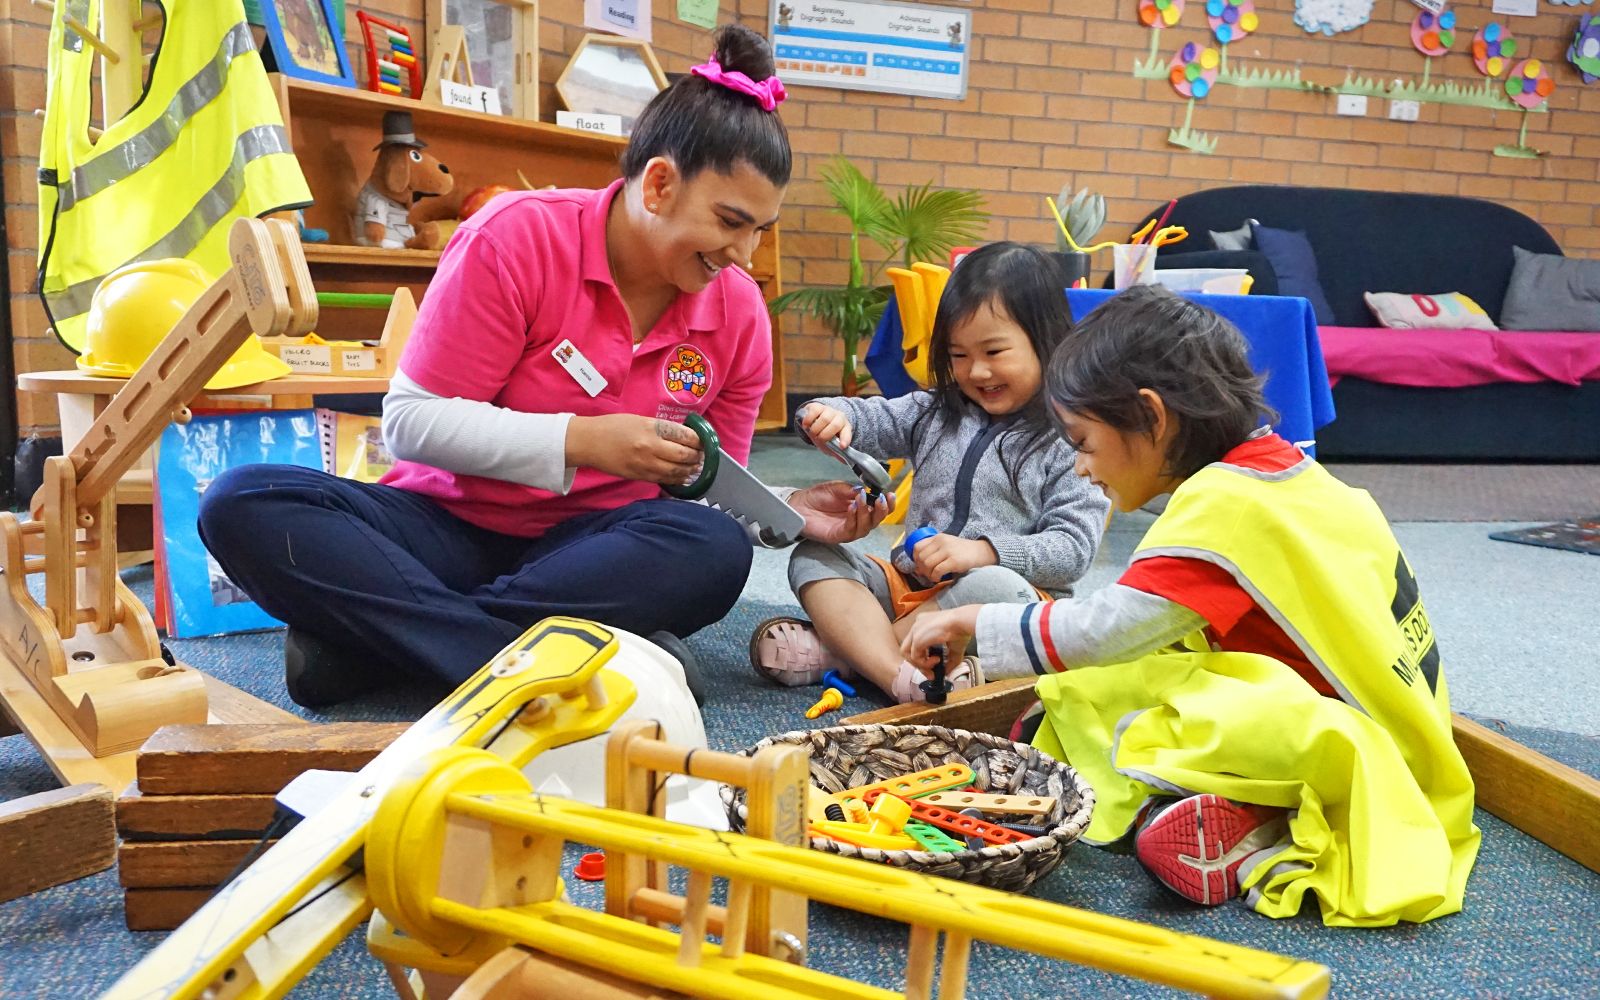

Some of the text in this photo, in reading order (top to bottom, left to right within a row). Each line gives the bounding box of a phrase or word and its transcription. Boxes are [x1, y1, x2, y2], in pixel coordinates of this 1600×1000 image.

[608, 7, 634, 23] Reading
[812, 5, 844, 17] Beginning
[831, 17, 855, 25] Sounds
[899, 14, 931, 23] Advanced
[917, 26, 940, 34] Sounds
[450, 88, 472, 104] found
[576, 118, 605, 131] float
